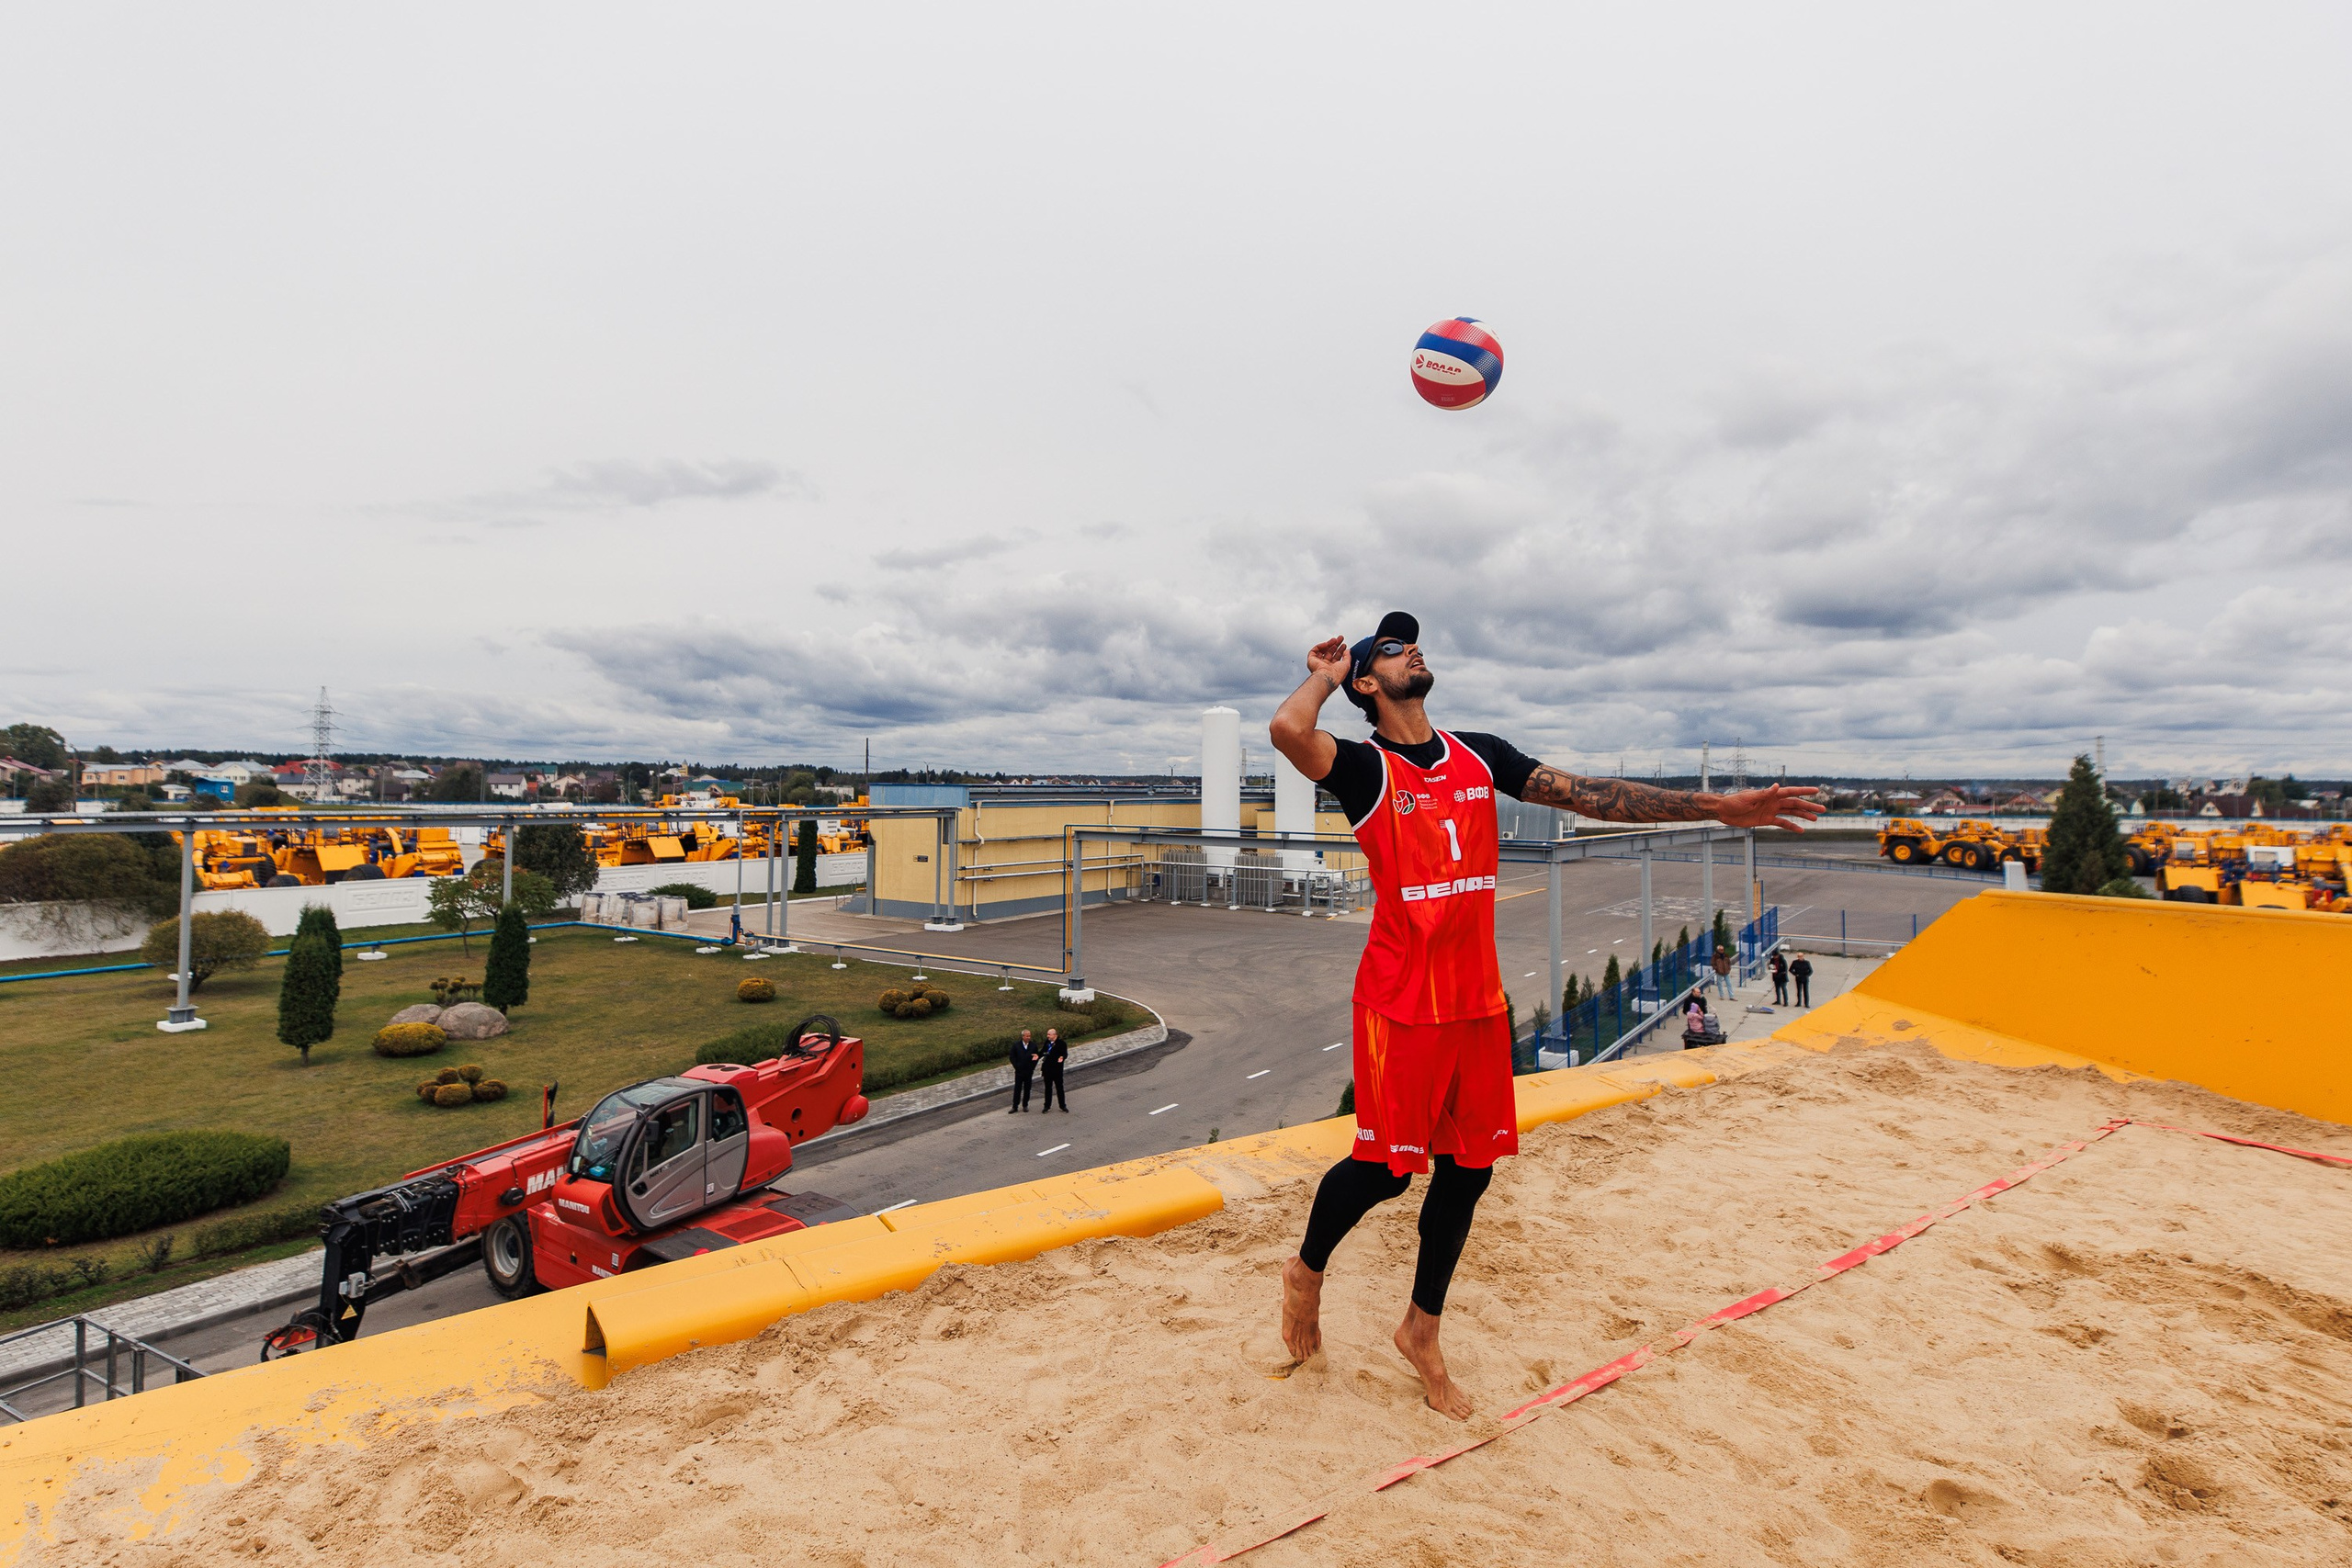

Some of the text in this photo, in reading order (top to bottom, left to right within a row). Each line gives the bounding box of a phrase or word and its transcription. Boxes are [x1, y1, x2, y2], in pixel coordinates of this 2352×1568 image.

[1466, 785, 1489, 801] ВФВ
[1439, 818, 1462, 862] 1
[1401, 875, 1496, 902] БЕЛАЗ
[352, 890, 414, 907] БЕЛАЗ
[558, 1198, 590, 1214] MANITOU
